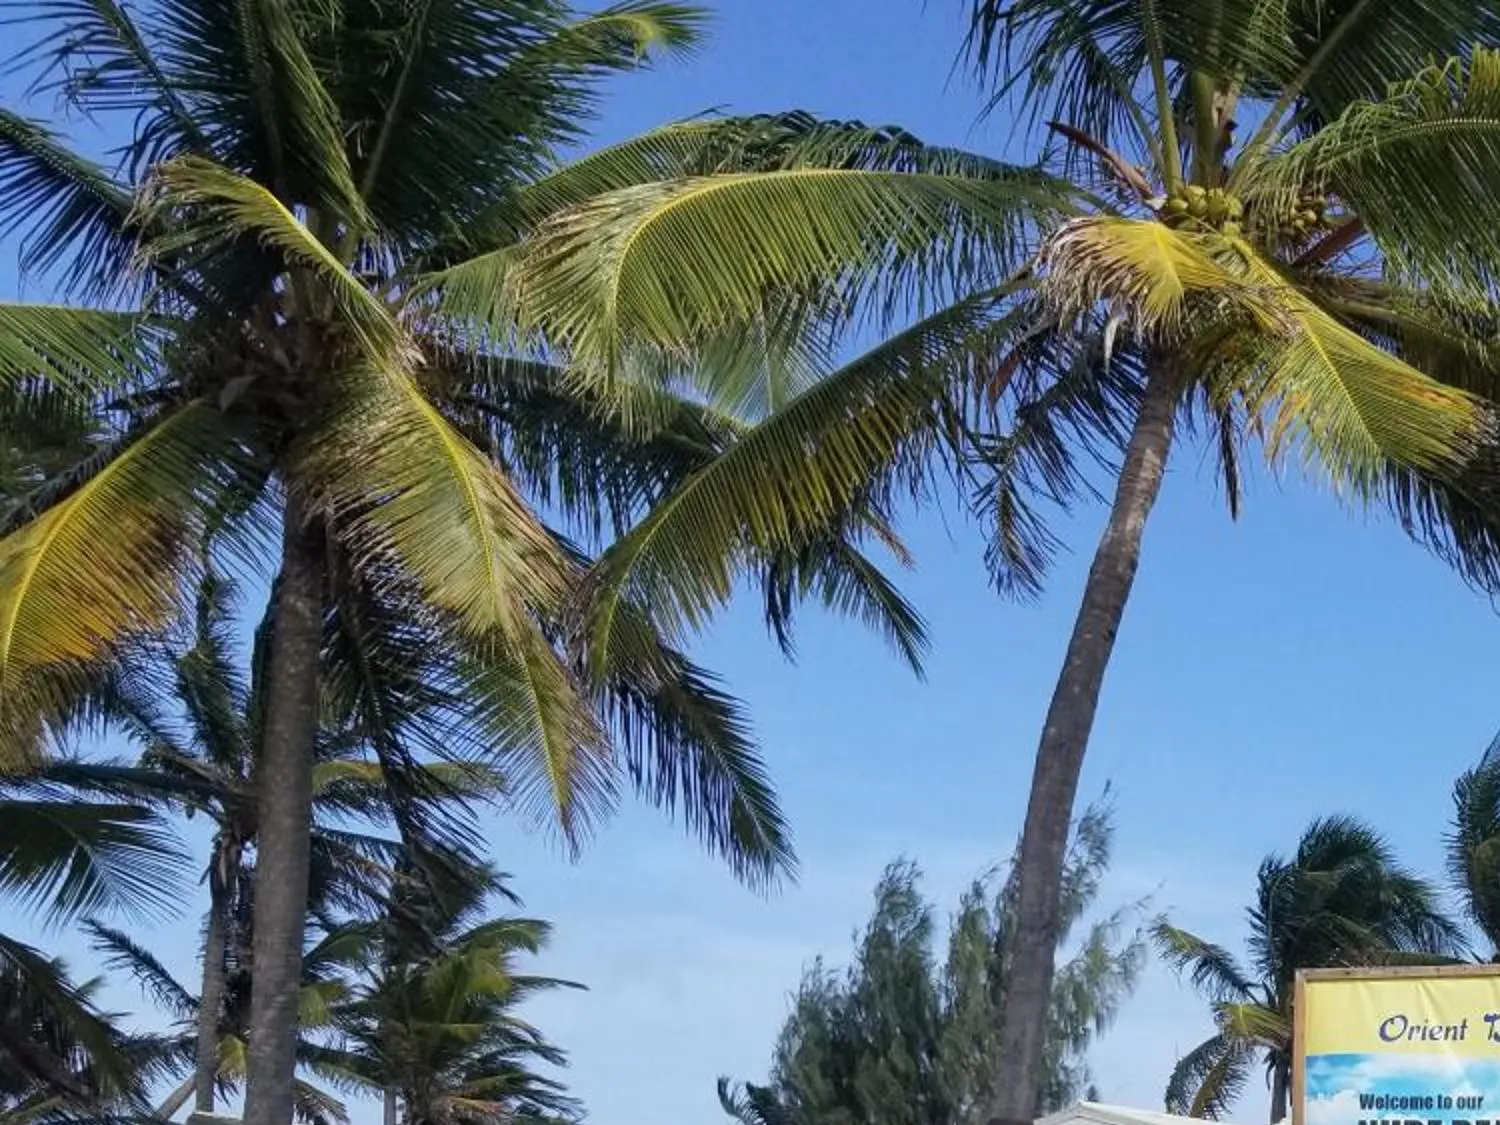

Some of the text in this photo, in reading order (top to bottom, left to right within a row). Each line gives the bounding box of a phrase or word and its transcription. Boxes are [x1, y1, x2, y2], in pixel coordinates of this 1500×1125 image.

[1379, 1013, 1468, 1043] Orient
[1359, 1093, 1485, 1111] Welcome to our
